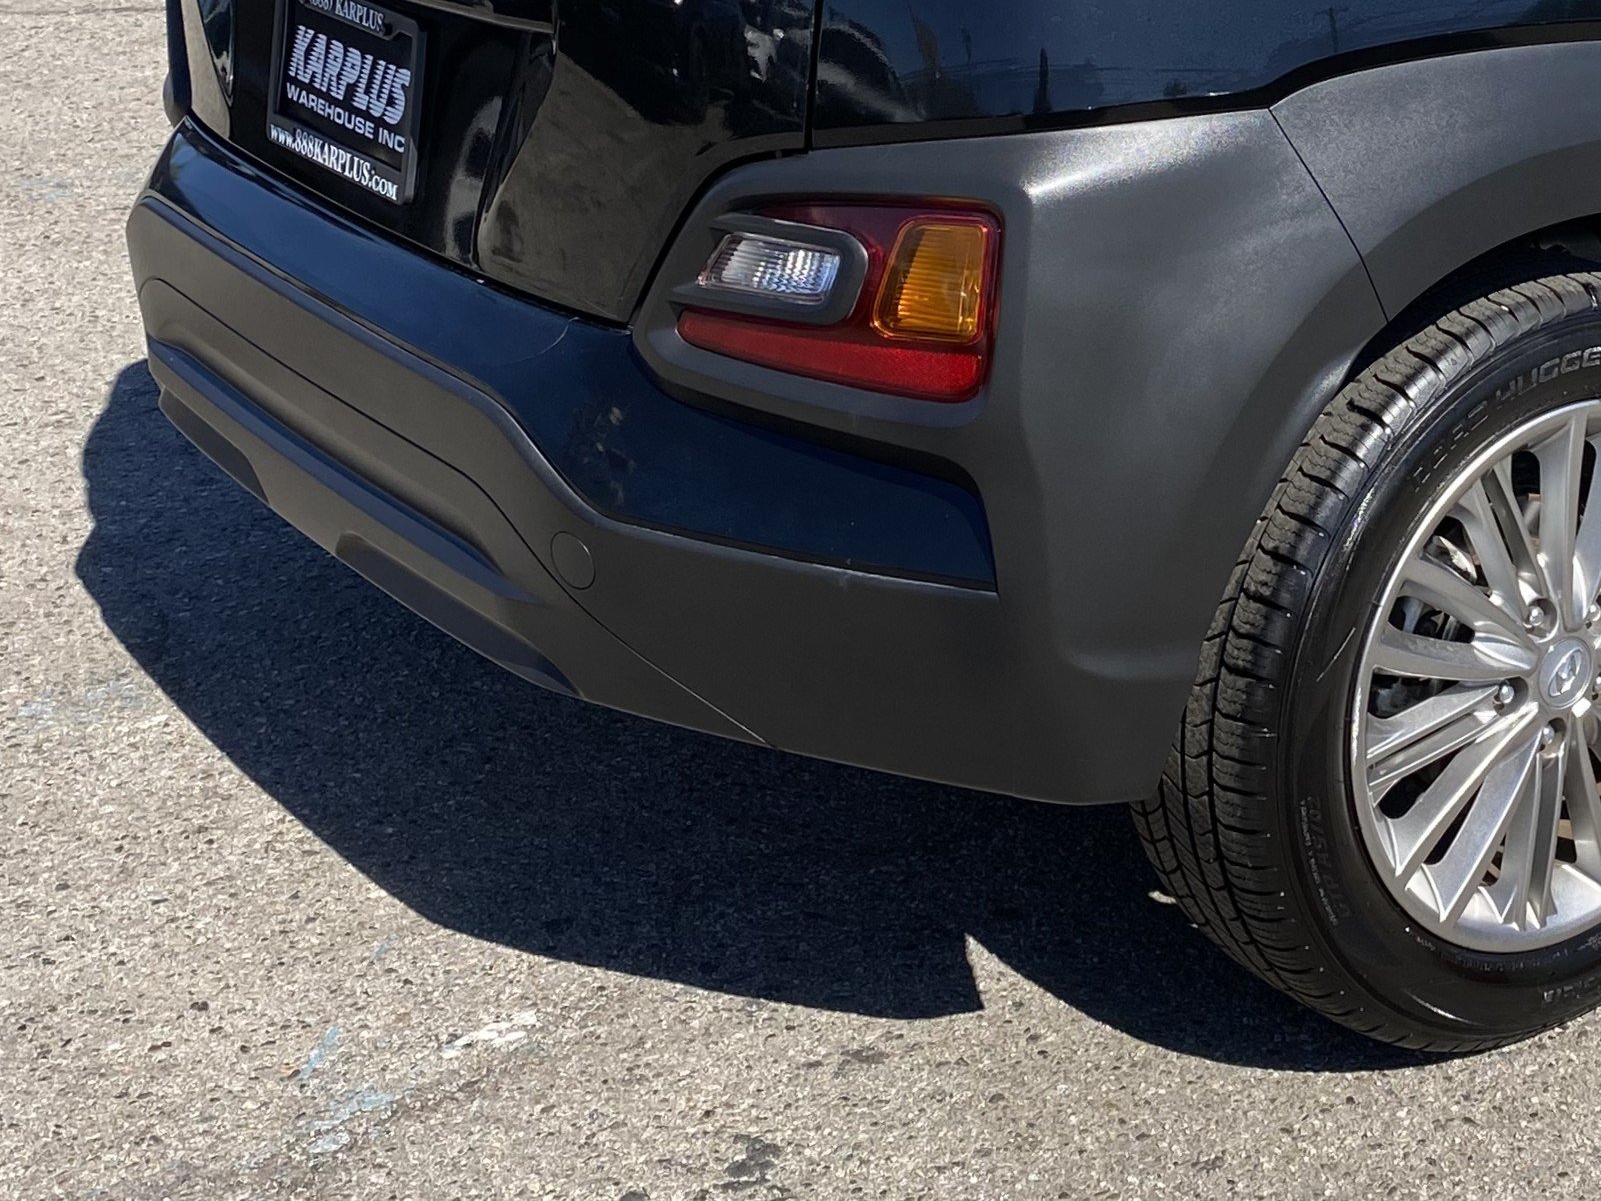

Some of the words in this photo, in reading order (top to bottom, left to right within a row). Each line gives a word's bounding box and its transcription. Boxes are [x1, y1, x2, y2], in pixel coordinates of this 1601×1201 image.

[286, 81, 374, 140] WAREHOUSE
[378, 126, 405, 154] INC
[287, 24, 411, 125] KARPLUS
